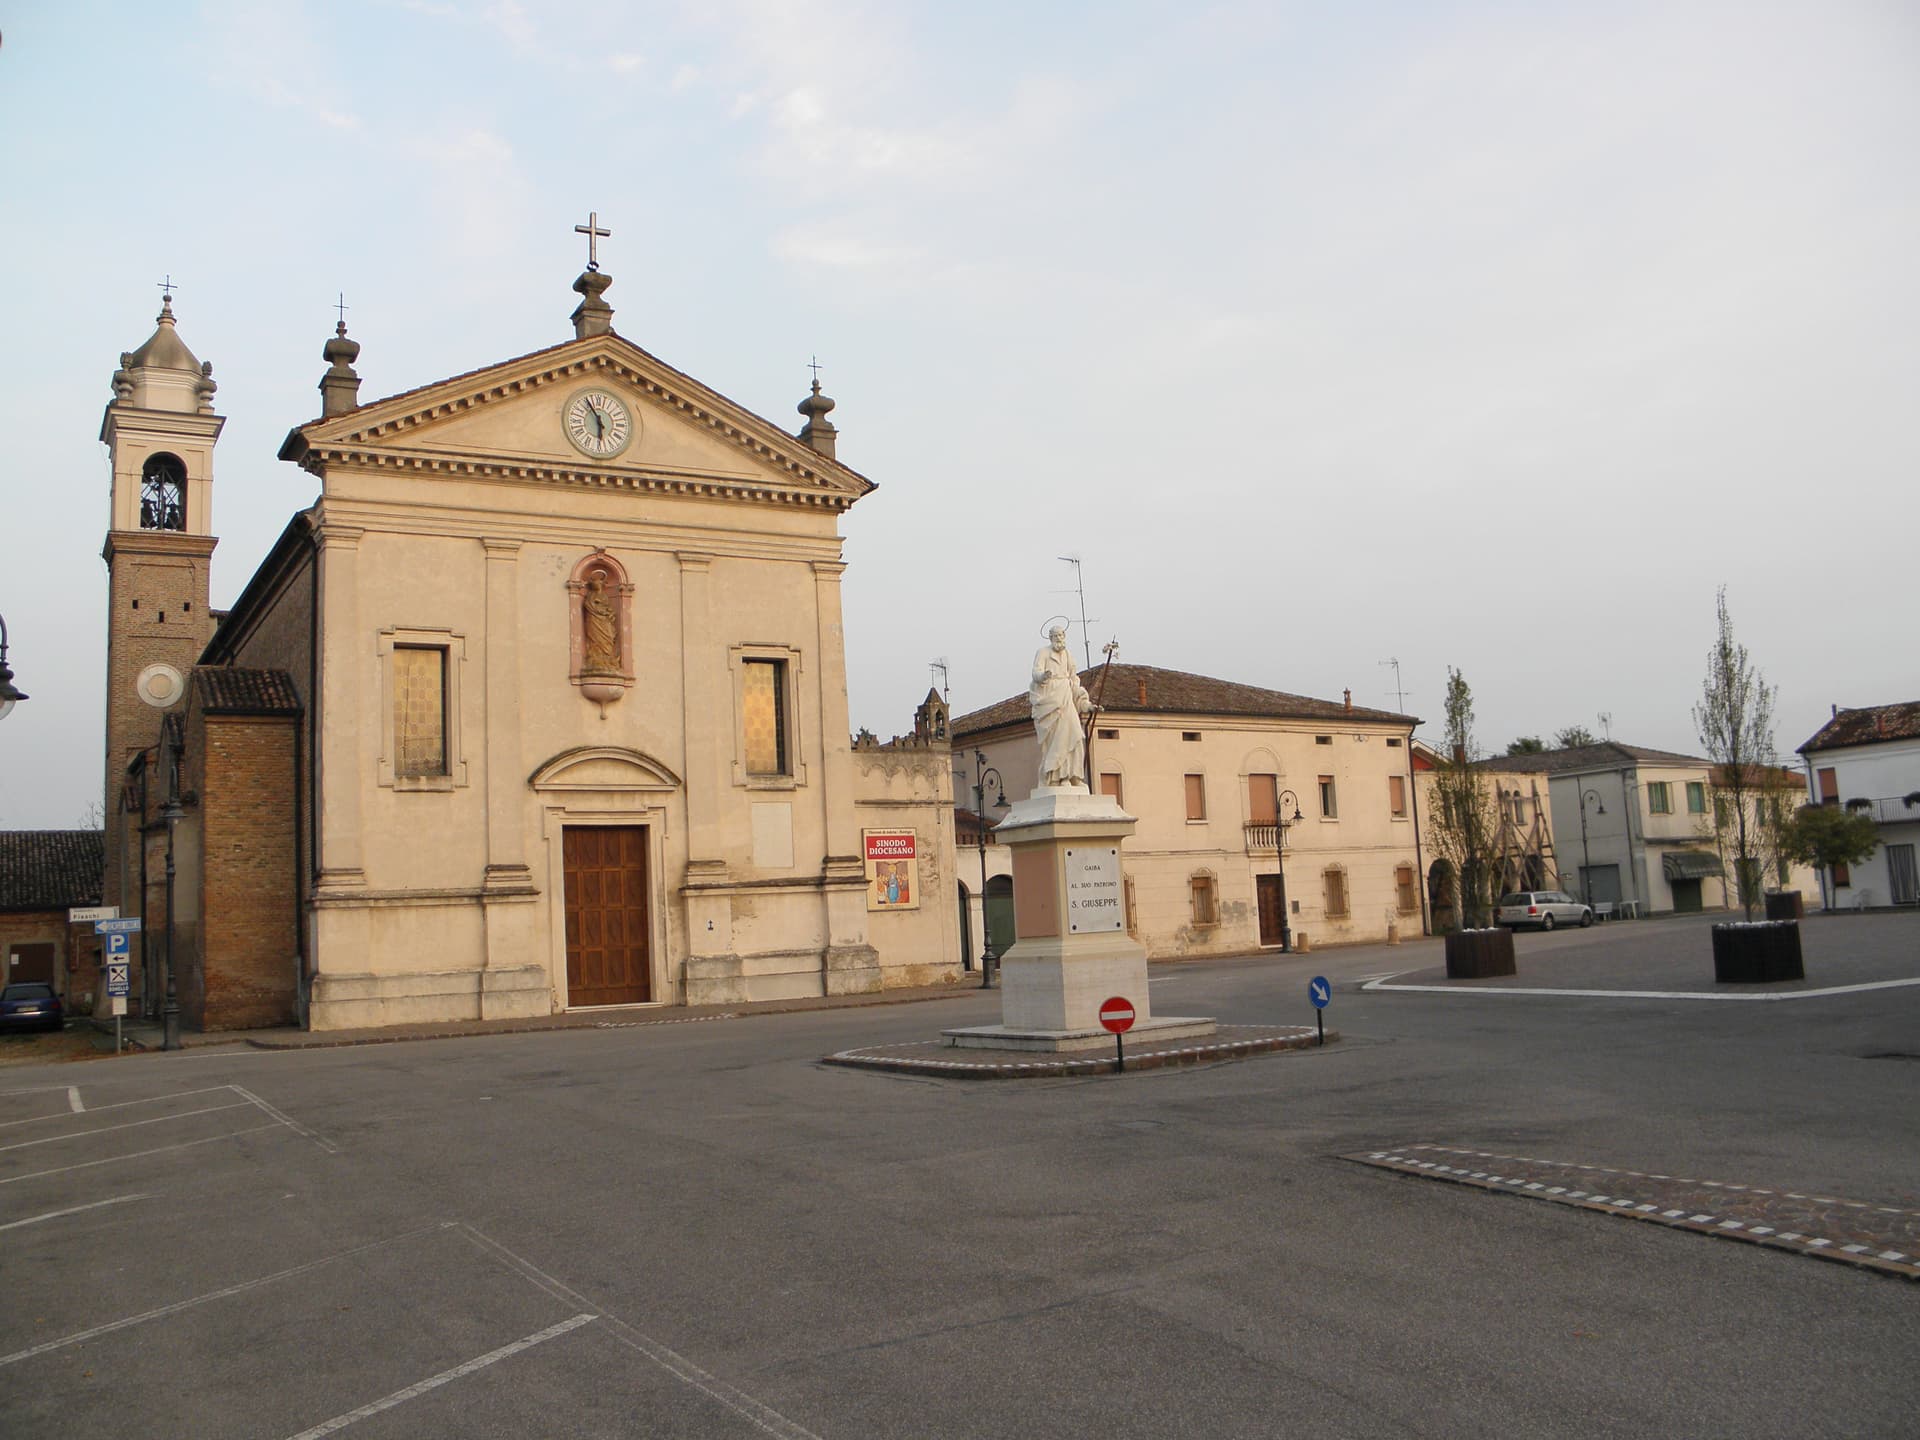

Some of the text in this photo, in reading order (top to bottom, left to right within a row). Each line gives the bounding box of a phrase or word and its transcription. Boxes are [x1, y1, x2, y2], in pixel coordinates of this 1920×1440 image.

[1071, 898, 1118, 909] S. GIUSEPPE
[110, 934, 125, 952] P
